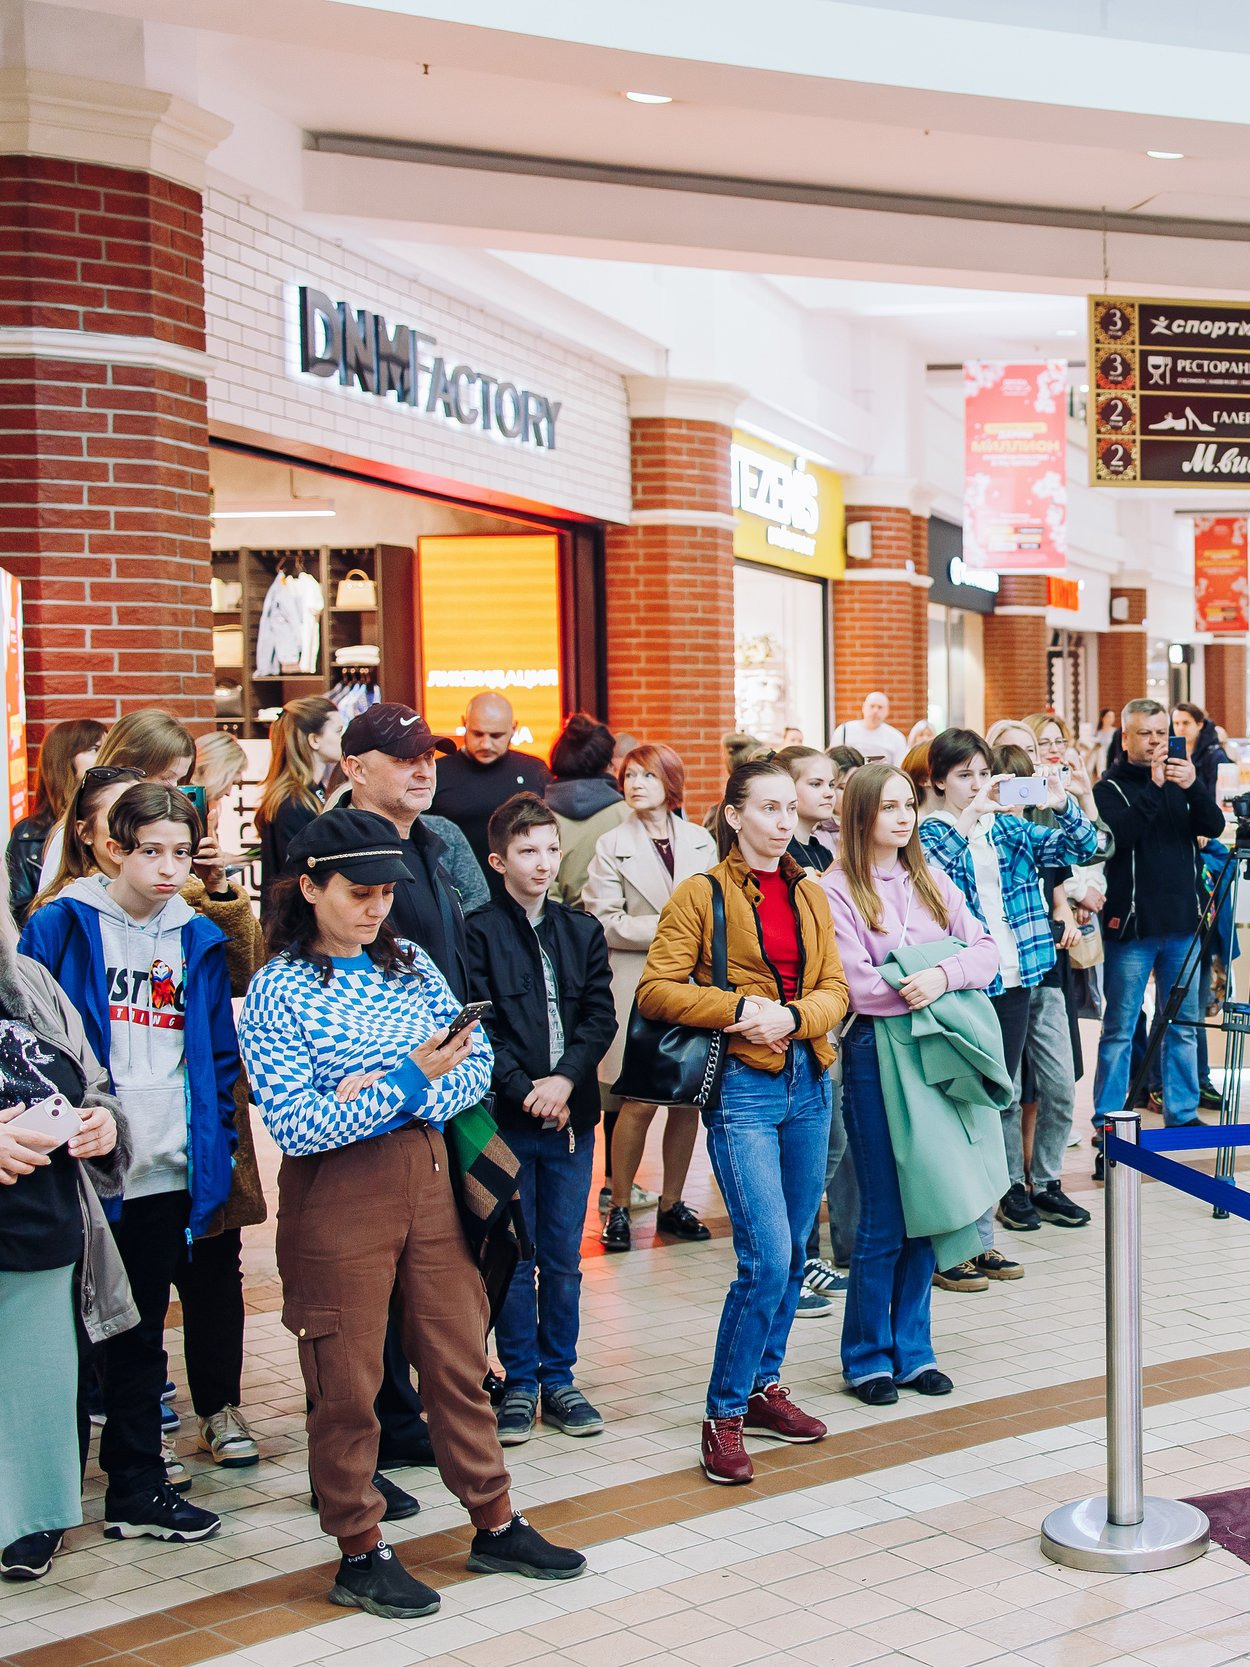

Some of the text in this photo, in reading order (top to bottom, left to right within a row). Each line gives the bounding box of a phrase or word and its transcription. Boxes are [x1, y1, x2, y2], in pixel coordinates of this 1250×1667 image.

[1109, 309, 1122, 330] 3
[1109, 354, 1122, 376] 3
[1109, 400, 1123, 421] 2
[1109, 444, 1123, 466] 2
